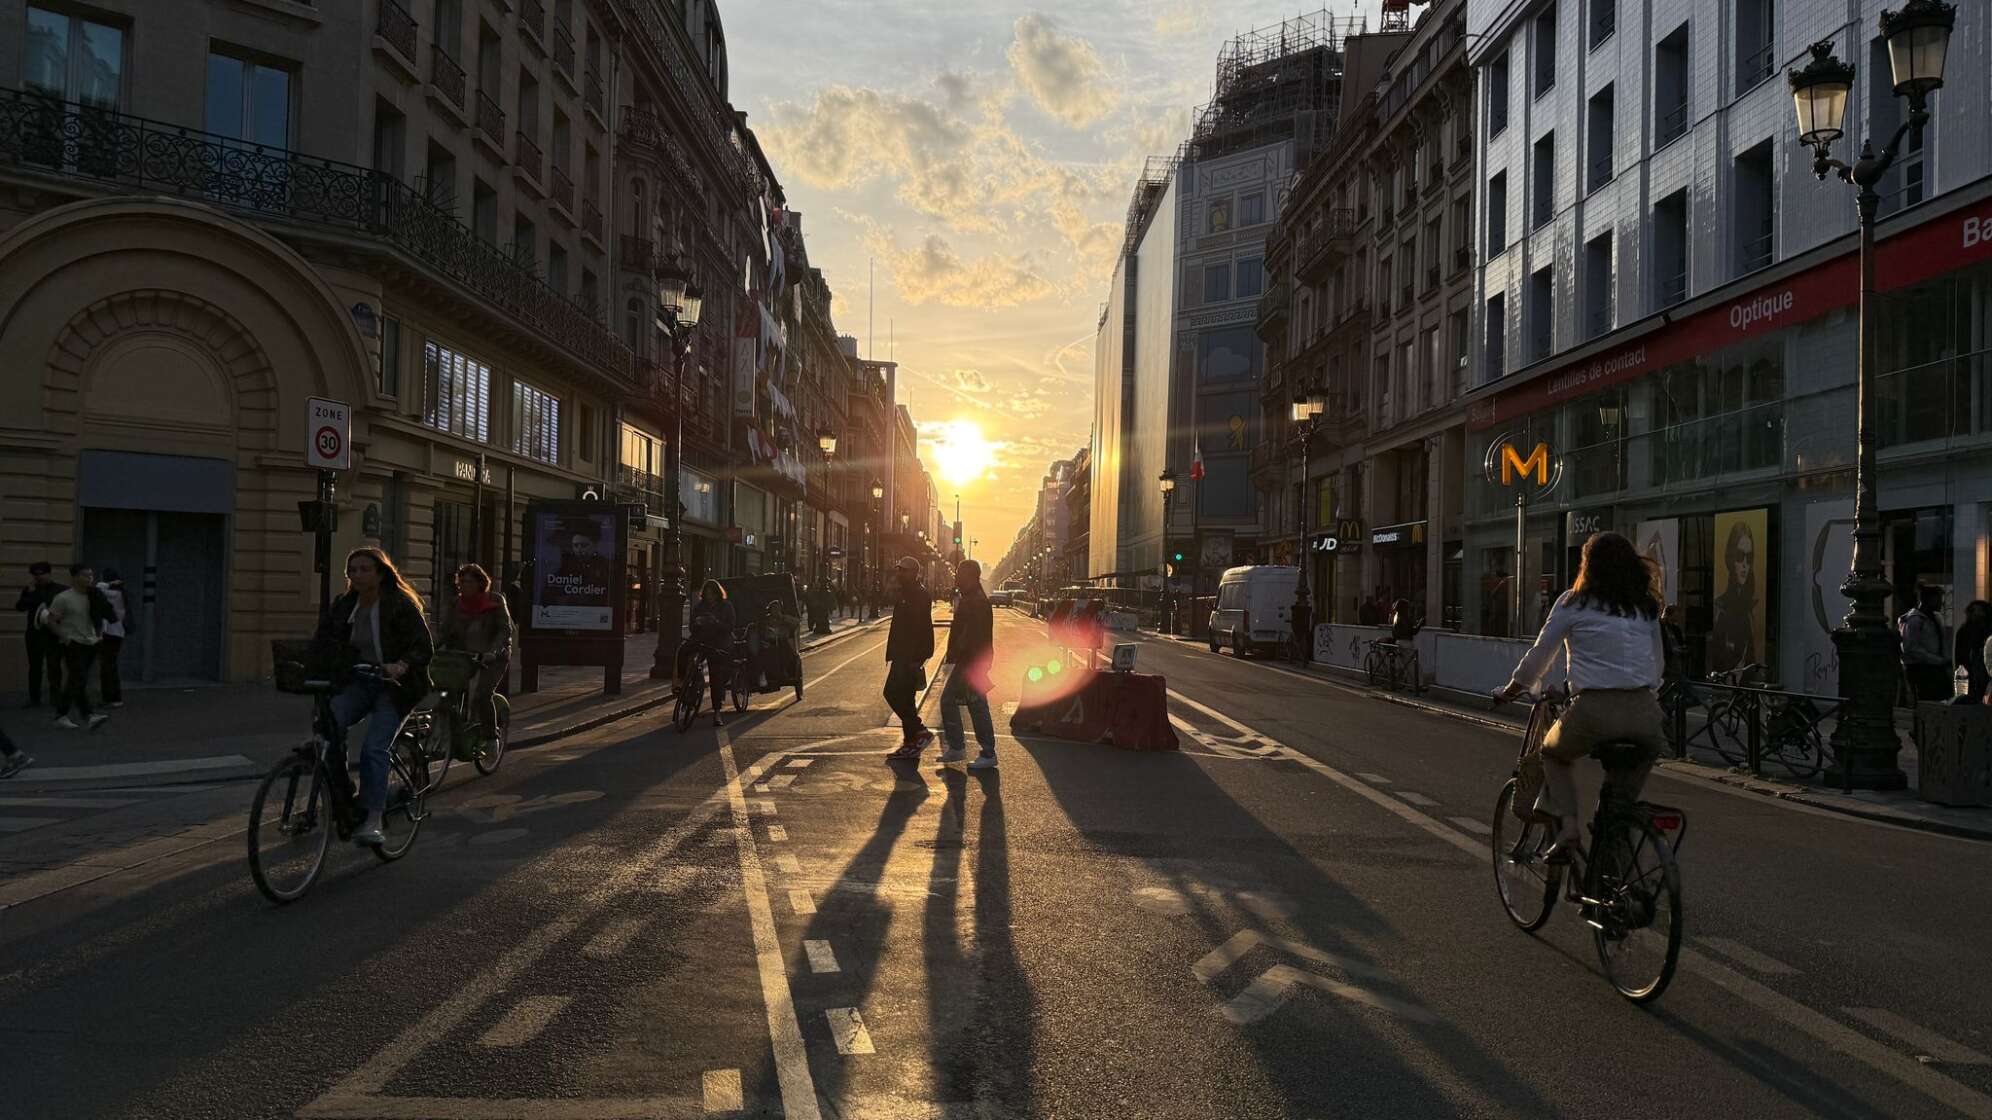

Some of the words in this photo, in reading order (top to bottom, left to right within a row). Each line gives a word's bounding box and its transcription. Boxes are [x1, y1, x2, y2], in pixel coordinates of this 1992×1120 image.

[1730, 290, 1793, 330] Optique
[1548, 367, 1586, 395] Lentilles
[1589, 362, 1602, 381] de
[1604, 344, 1646, 375] contact
[315, 407, 344, 420] ZONE
[321, 435, 336, 450] 30
[1501, 441, 1549, 487] M
[1319, 538, 1337, 550] JD
[546, 574, 583, 585] Daniel
[564, 583, 607, 595] Cordier
